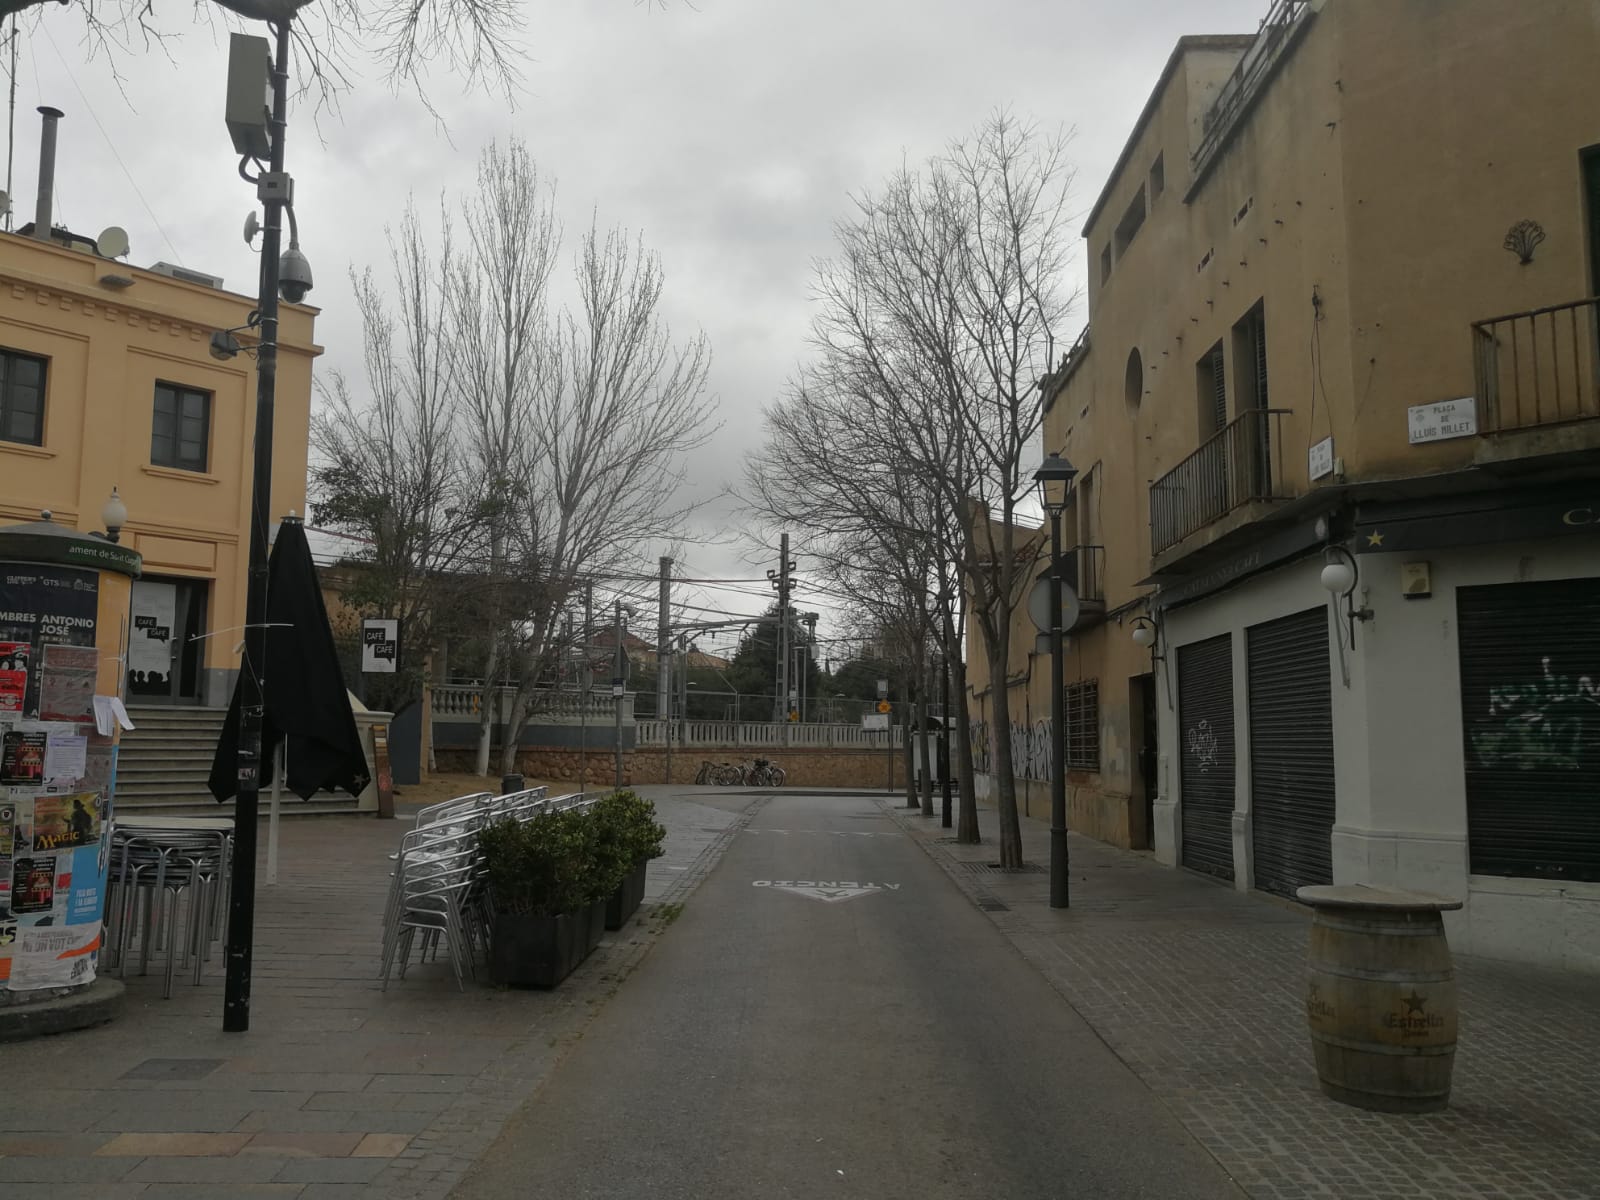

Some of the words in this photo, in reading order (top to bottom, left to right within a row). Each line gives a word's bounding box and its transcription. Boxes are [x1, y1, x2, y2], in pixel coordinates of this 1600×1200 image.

[1433, 404, 1456, 414] PLAÇA
[1441, 415, 1449, 423] DE
[1441, 422, 1470, 436] MILLET
[99, 549, 110, 560] de
[40, 614, 94, 629] ANTONIO
[40, 624, 70, 636] JOSÉ
[366, 632, 384, 641] CAFÉ
[377, 645, 393, 653] CAFÉ
